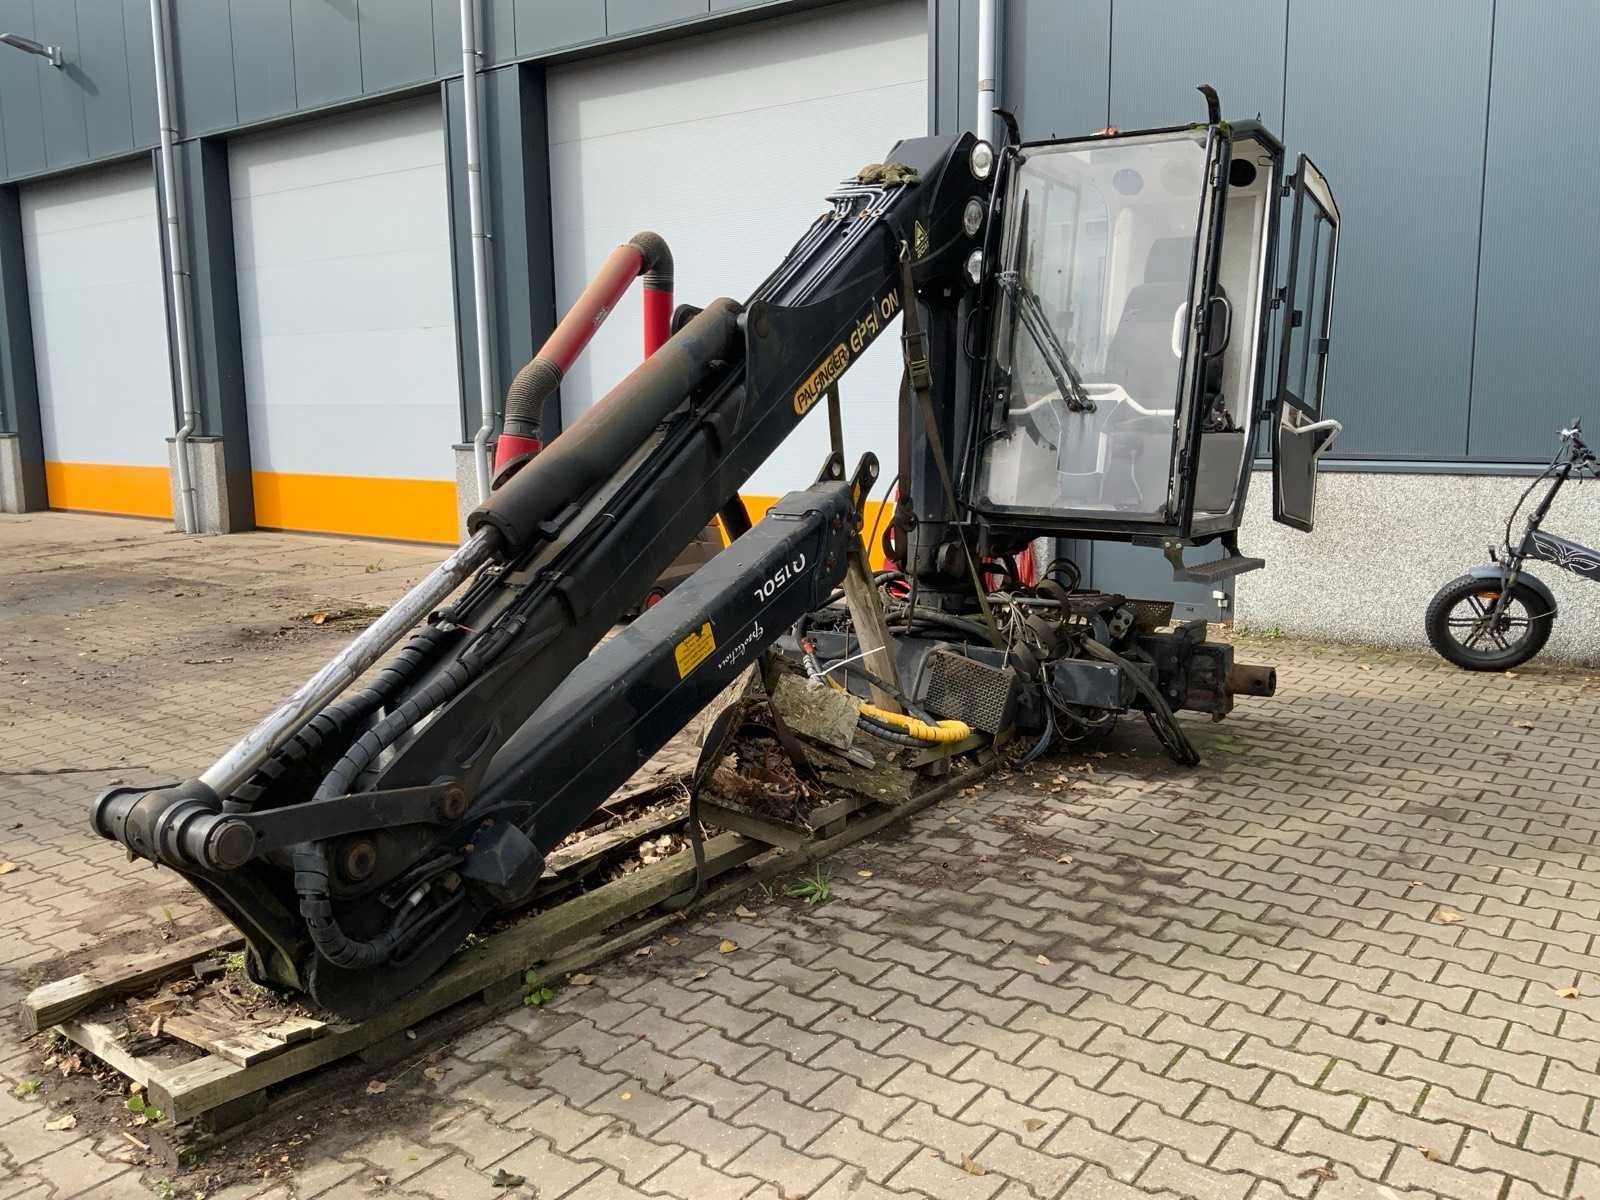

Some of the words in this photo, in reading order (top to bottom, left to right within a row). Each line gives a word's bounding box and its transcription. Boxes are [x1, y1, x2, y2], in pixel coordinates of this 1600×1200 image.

[796, 346, 849, 411] PALFINGER
[850, 288, 900, 353] EPSION
[754, 553, 806, 602] Q150L
